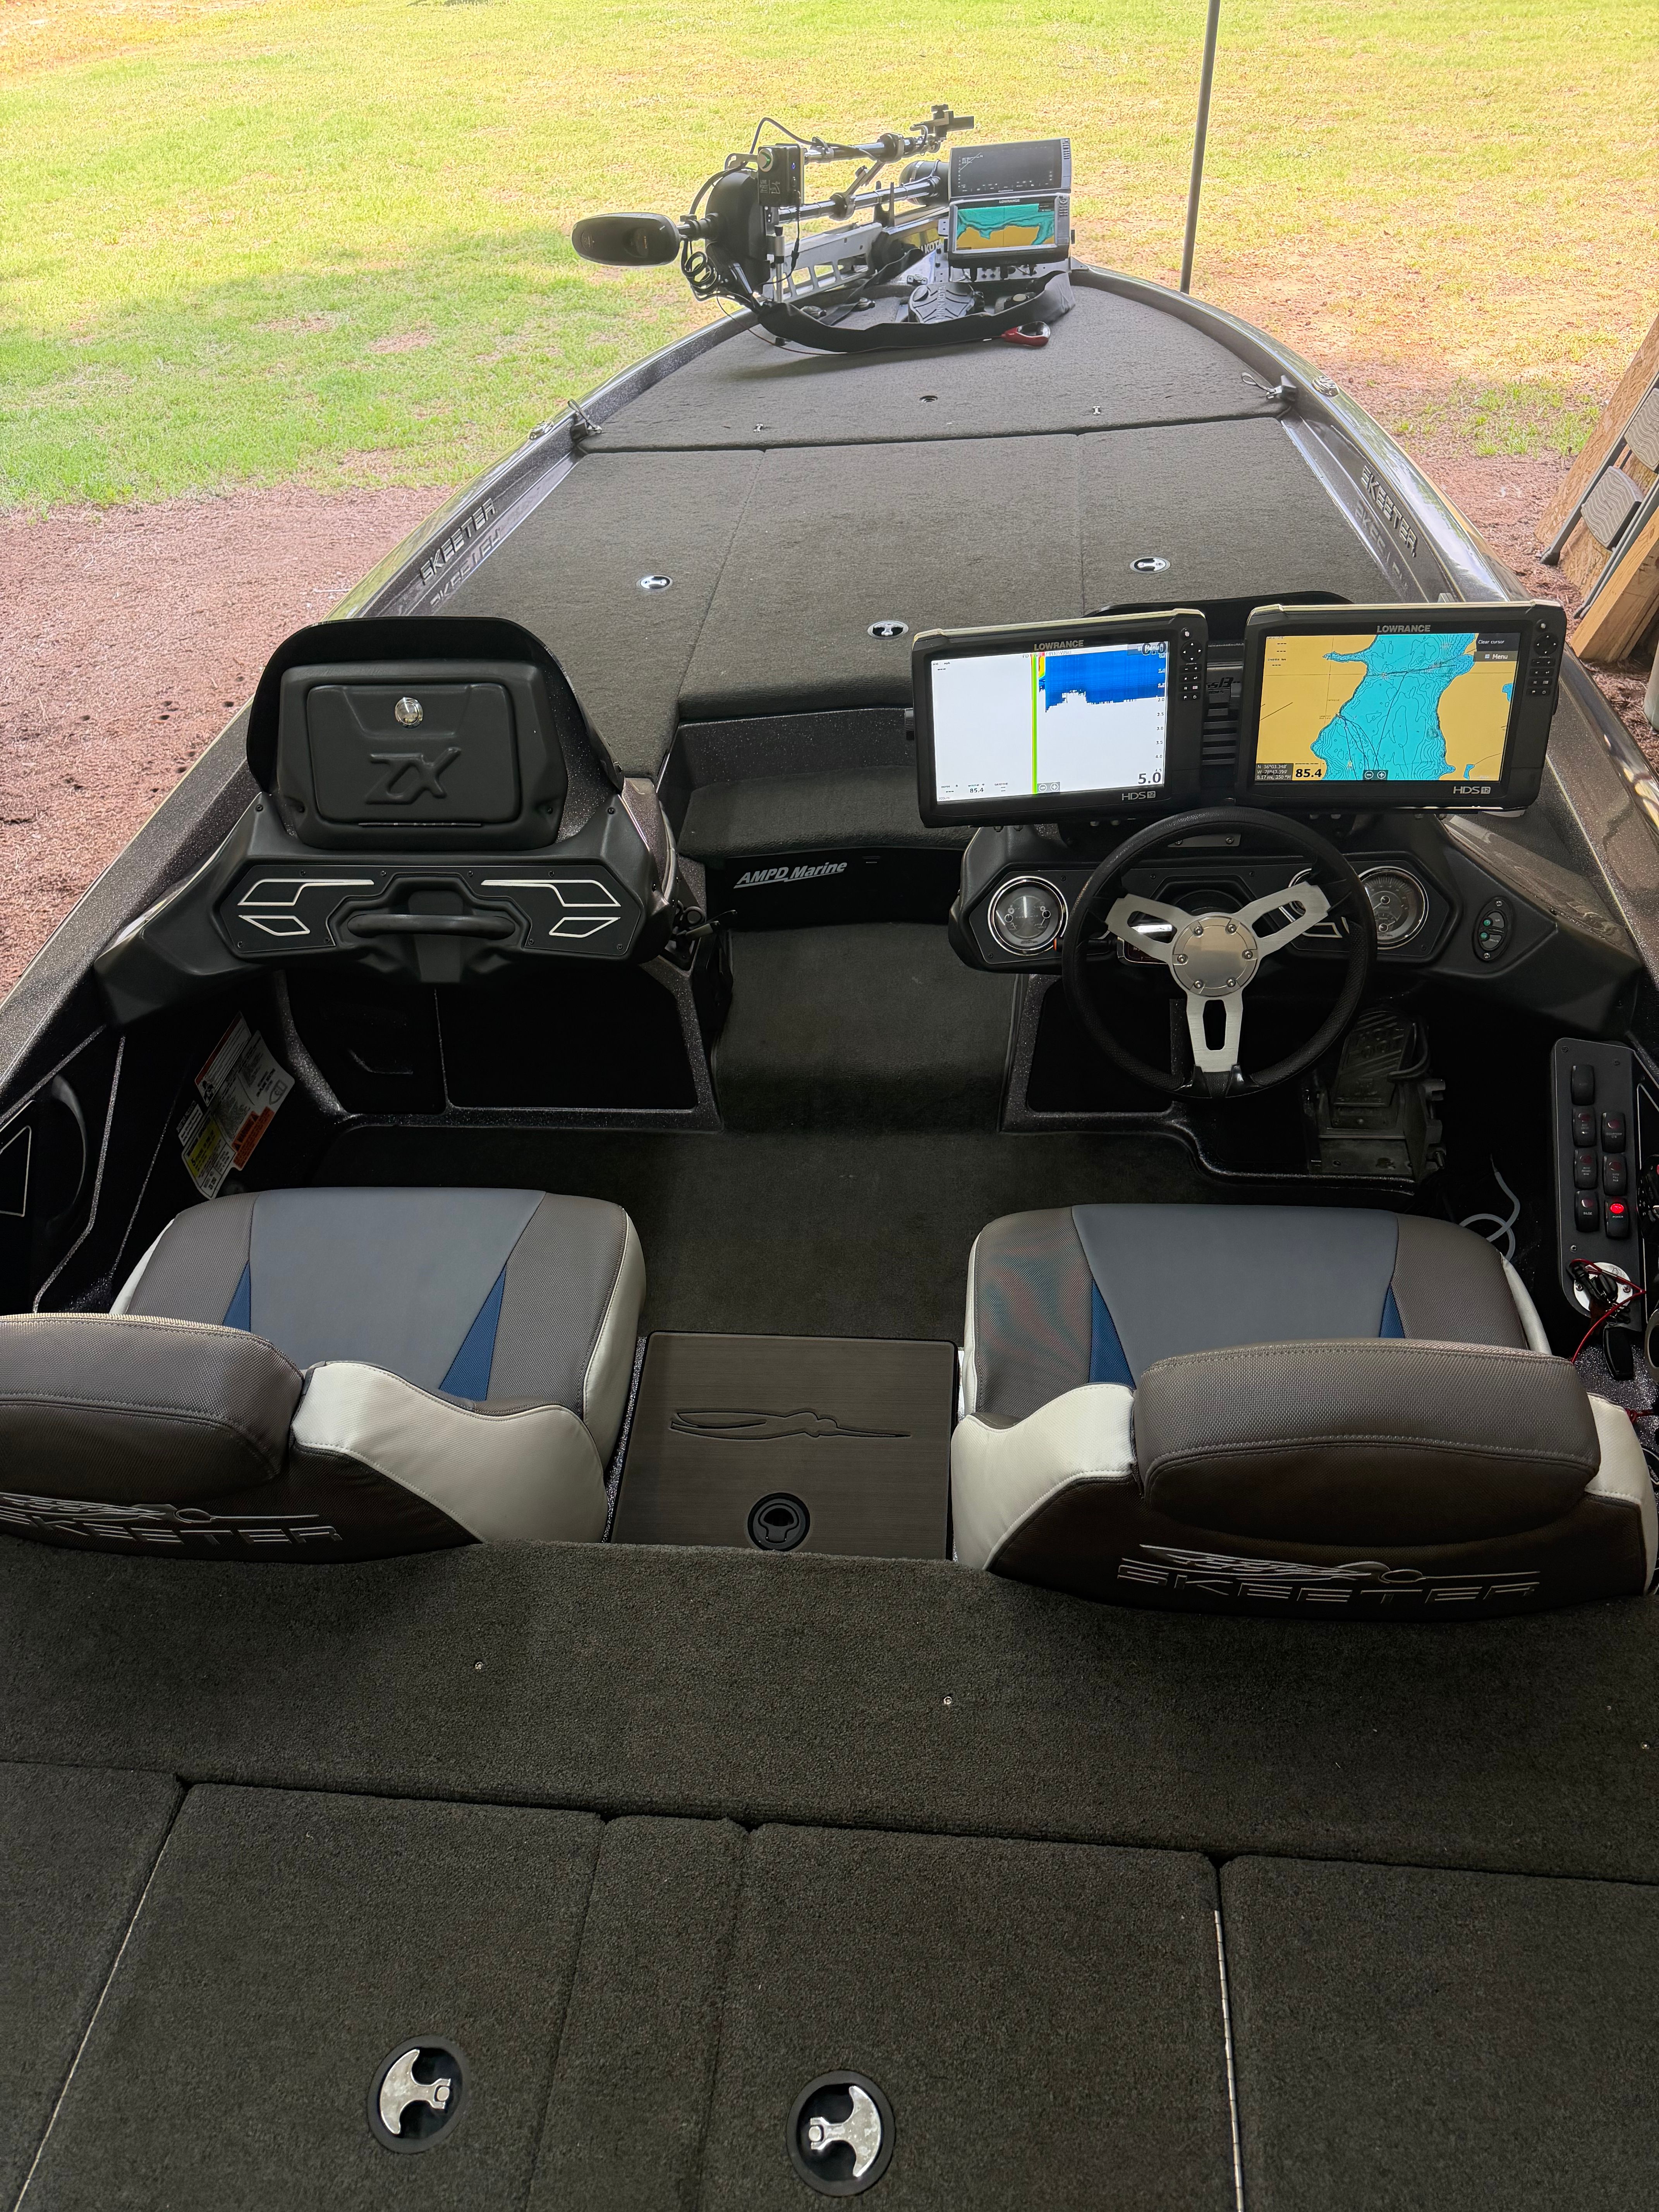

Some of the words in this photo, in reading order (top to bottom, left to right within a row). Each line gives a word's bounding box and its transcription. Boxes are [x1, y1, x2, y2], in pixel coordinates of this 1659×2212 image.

[1361, 465, 1417, 558] SKEETER
[420, 498, 495, 586] SKEETER
[1377, 625, 1431, 633] LOWRANCE
[1034, 640, 1084, 651] LOWRANCE
[365, 747, 462, 805] ZX
[1138, 773, 1161, 784] 5.0
[1296, 769, 1322, 778] 85.4
[1122, 792, 1146, 800] HDS
[737, 867, 789, 884] AMPD
[790, 862, 847, 879] Marine
[1117, 1563, 1540, 1604] SKEETER
